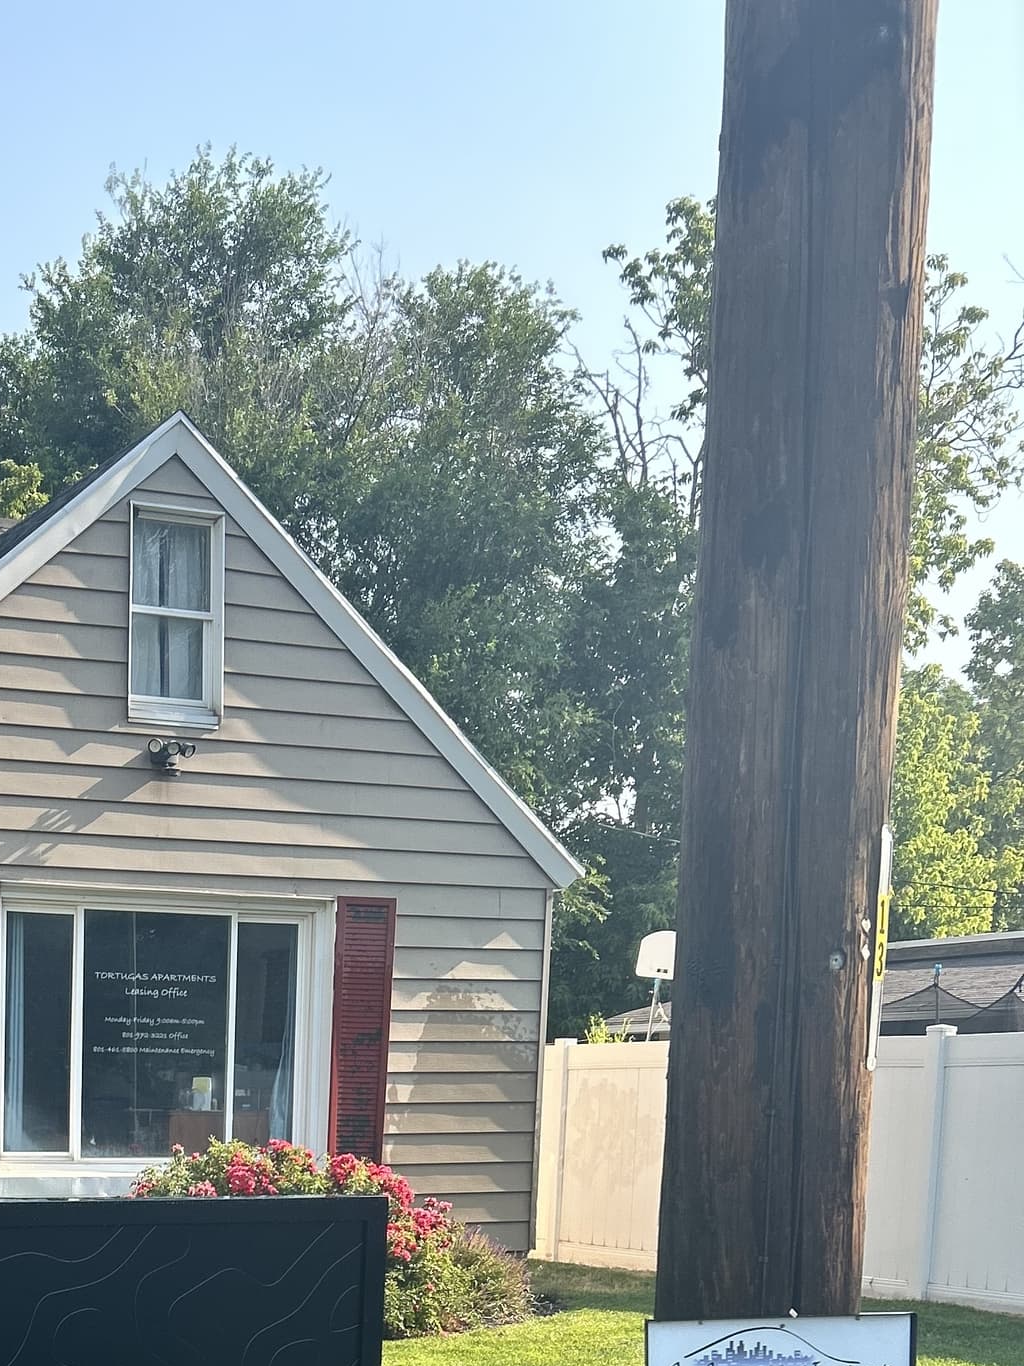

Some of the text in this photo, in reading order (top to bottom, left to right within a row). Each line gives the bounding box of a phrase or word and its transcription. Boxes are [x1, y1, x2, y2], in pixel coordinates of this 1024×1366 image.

[95, 971, 217, 983] TORTUGAS APARTMENTS
[125, 986, 188, 999] Leasing Office
[168, 1031, 189, 1041] Office
[139, 1045, 179, 1055] Maintenance
[180, 1047, 215, 1058] Emergency
